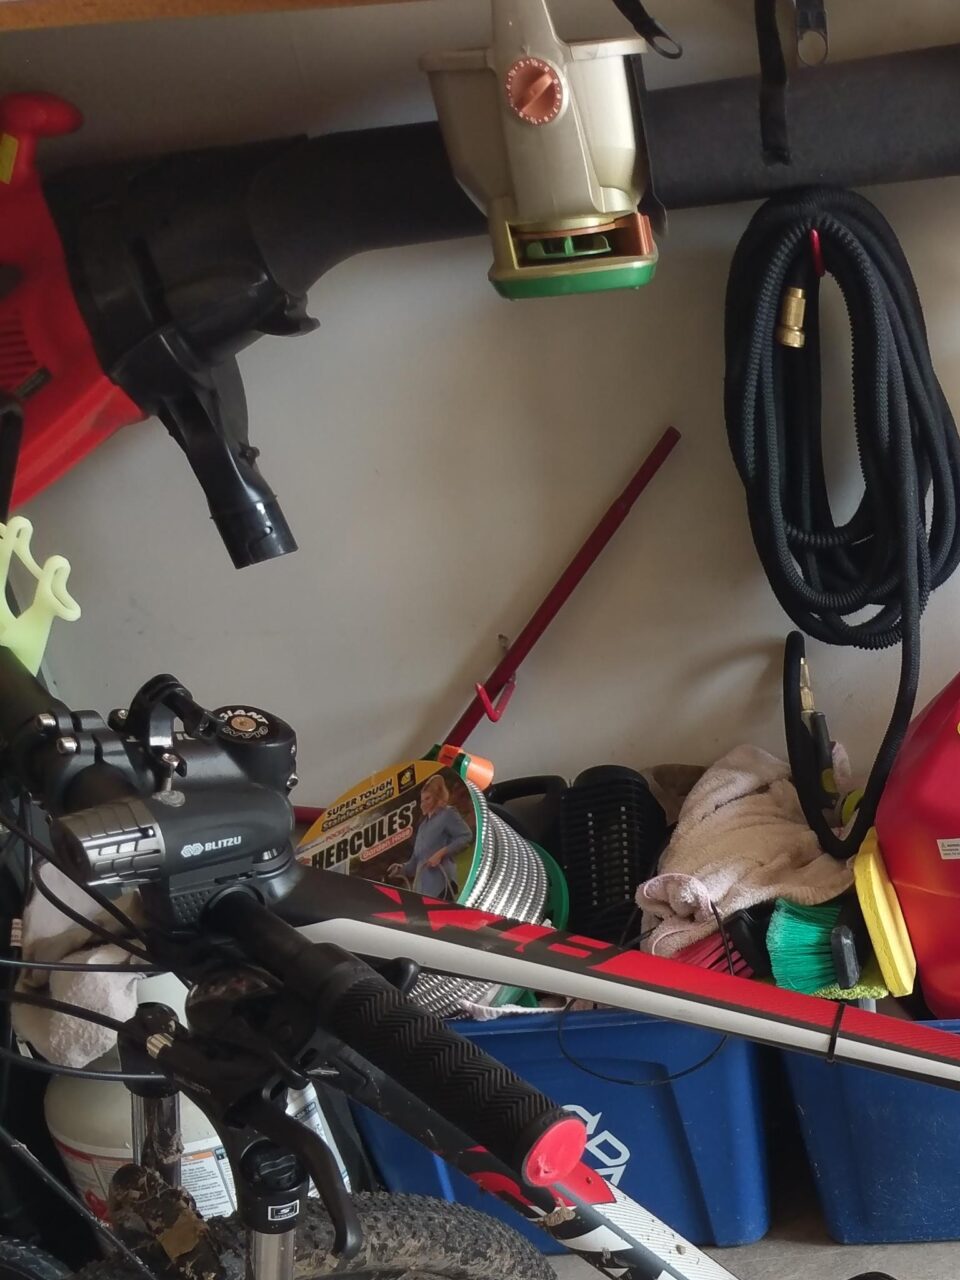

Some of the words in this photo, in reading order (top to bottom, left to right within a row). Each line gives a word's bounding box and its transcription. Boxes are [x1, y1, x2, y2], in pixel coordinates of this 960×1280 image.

[218, 708, 270, 726] GIANT
[326, 796, 357, 818] SUPER
[358, 778, 393, 802] TOUGH
[204, 835, 242, 852] BLITZU
[311, 804, 413, 870] HERCULES
